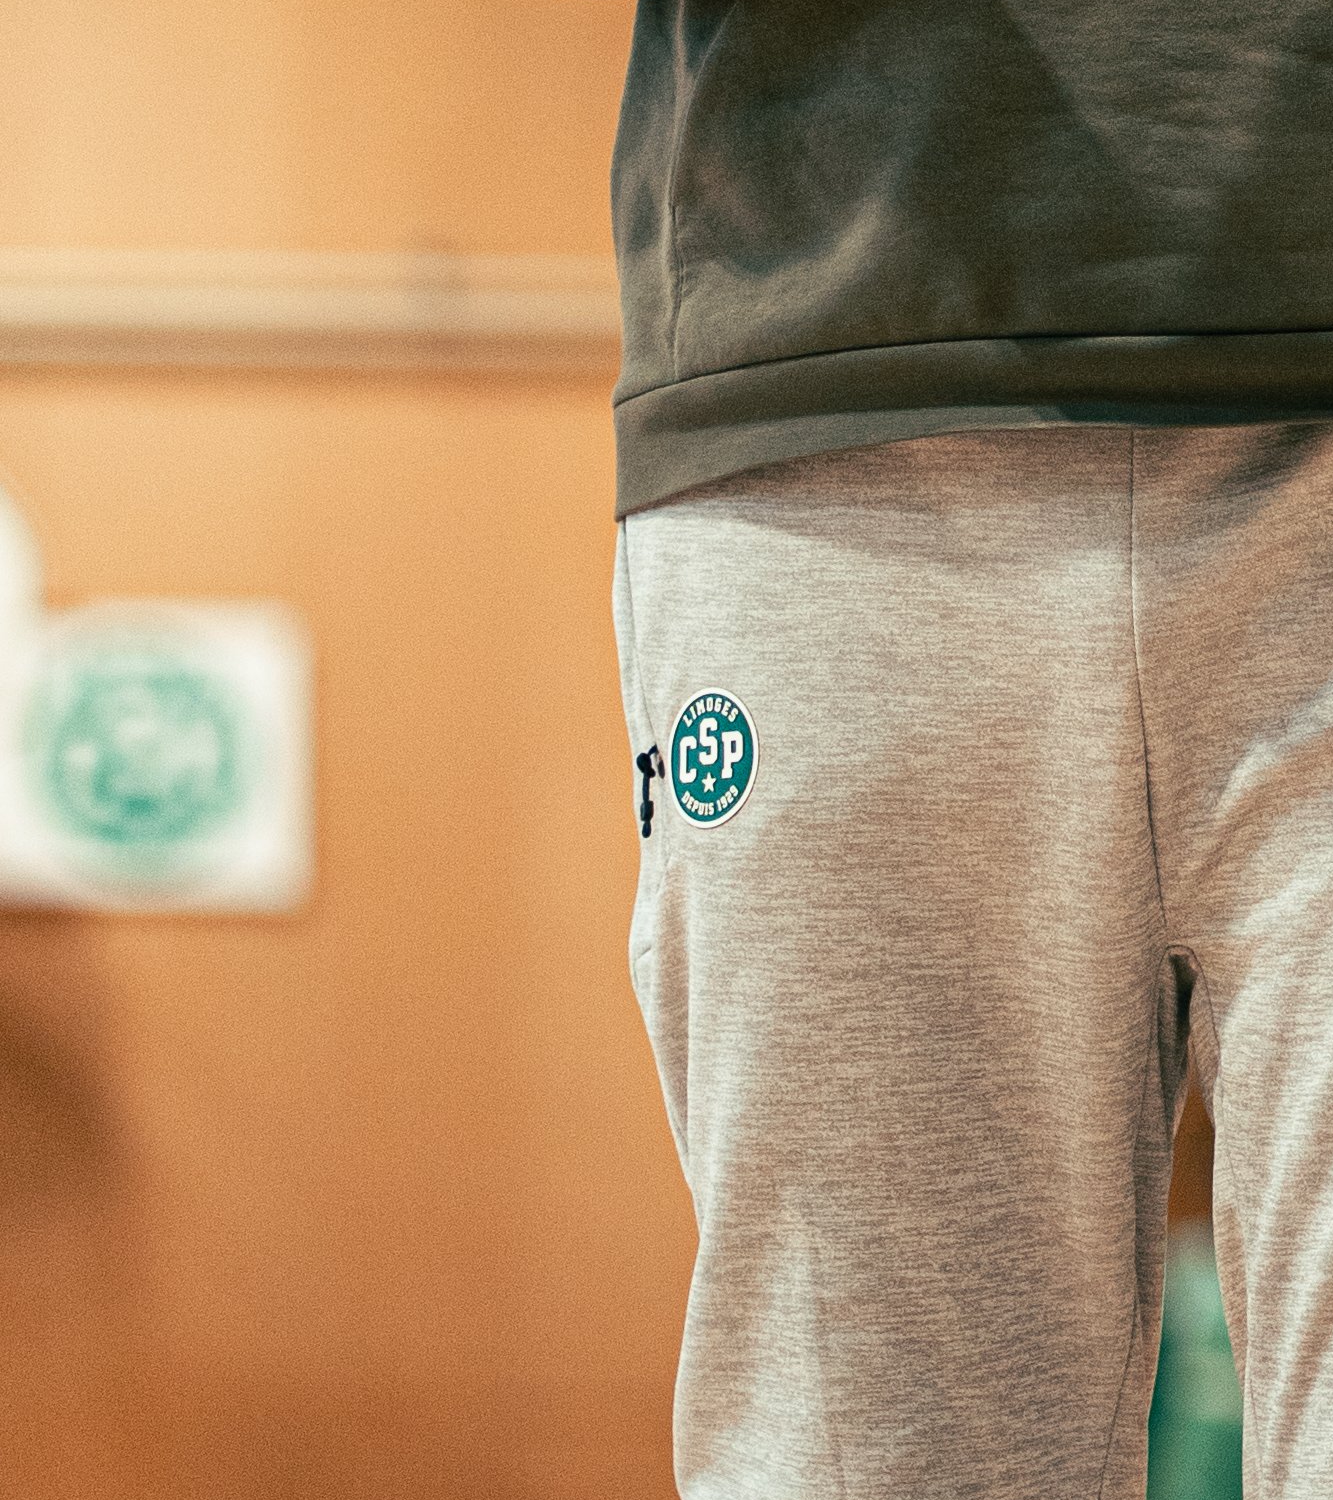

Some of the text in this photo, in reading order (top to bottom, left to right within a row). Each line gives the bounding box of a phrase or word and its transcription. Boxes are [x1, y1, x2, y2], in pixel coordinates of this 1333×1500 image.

[682, 696, 740, 728] LIMOGES
[678, 716, 744, 784] CSP
[681, 784, 740, 816] DEPUIS 1929
